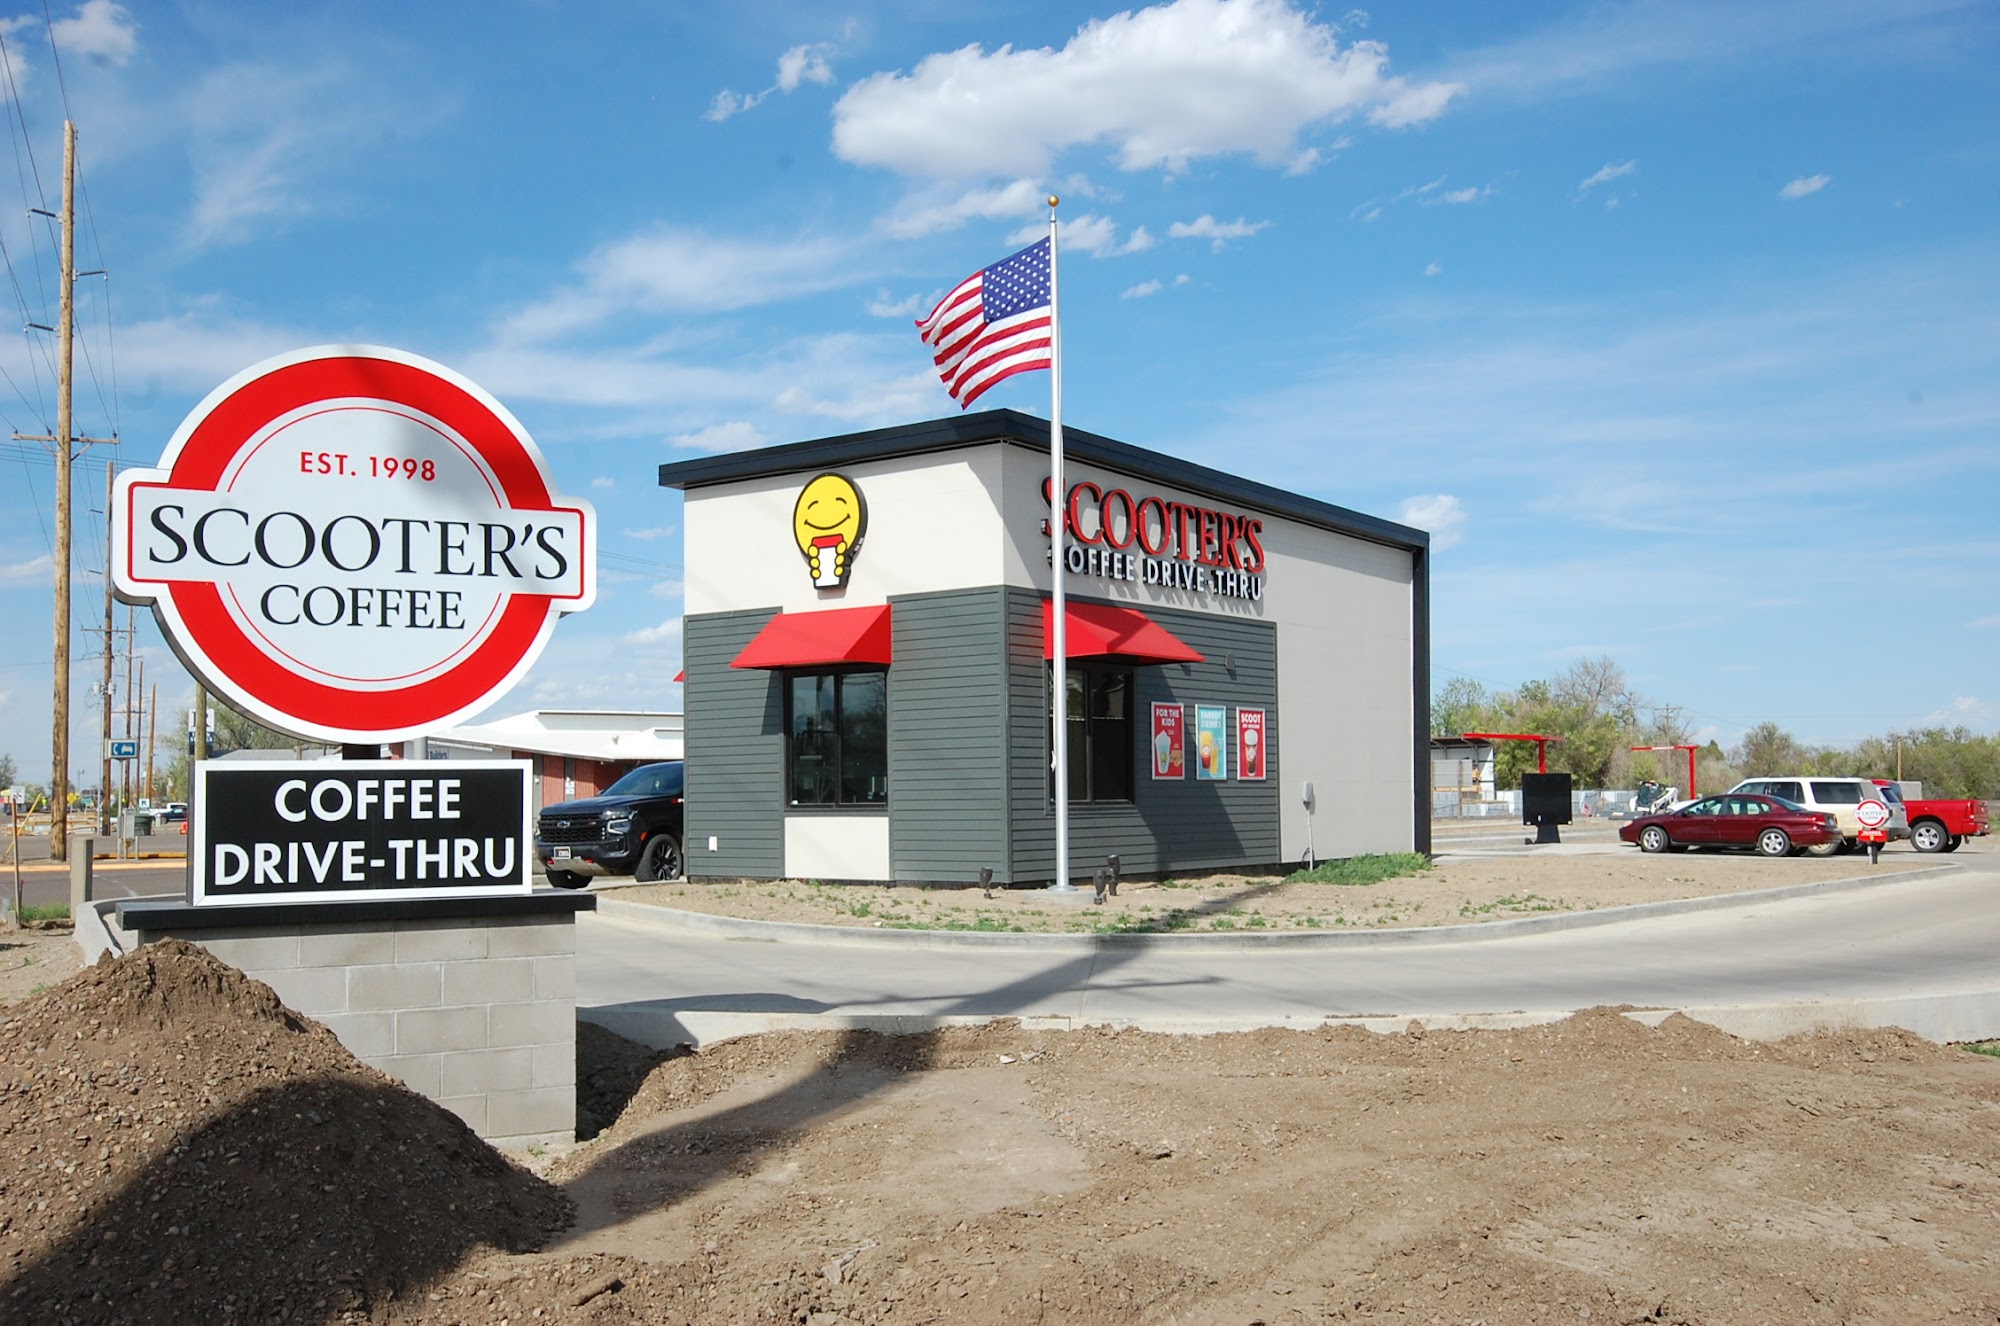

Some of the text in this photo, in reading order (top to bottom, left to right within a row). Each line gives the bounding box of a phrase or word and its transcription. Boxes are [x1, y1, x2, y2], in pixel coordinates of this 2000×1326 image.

[300, 451, 437, 482] EST. 1998
[148, 504, 568, 581] SCOOTER'S
[1041, 475, 1266, 573] SCOOTER'S
[1143, 557, 1263, 601] DRIVE-THRU
[260, 584, 466, 631] COFFEE
[1156, 708, 1169, 718] FOR
[1161, 718, 1175, 727] KIDS
[1241, 713, 1261, 723] SCOOT
[275, 779, 462, 823] COFFEE
[214, 837, 515, 886] DRIVE-THRU
